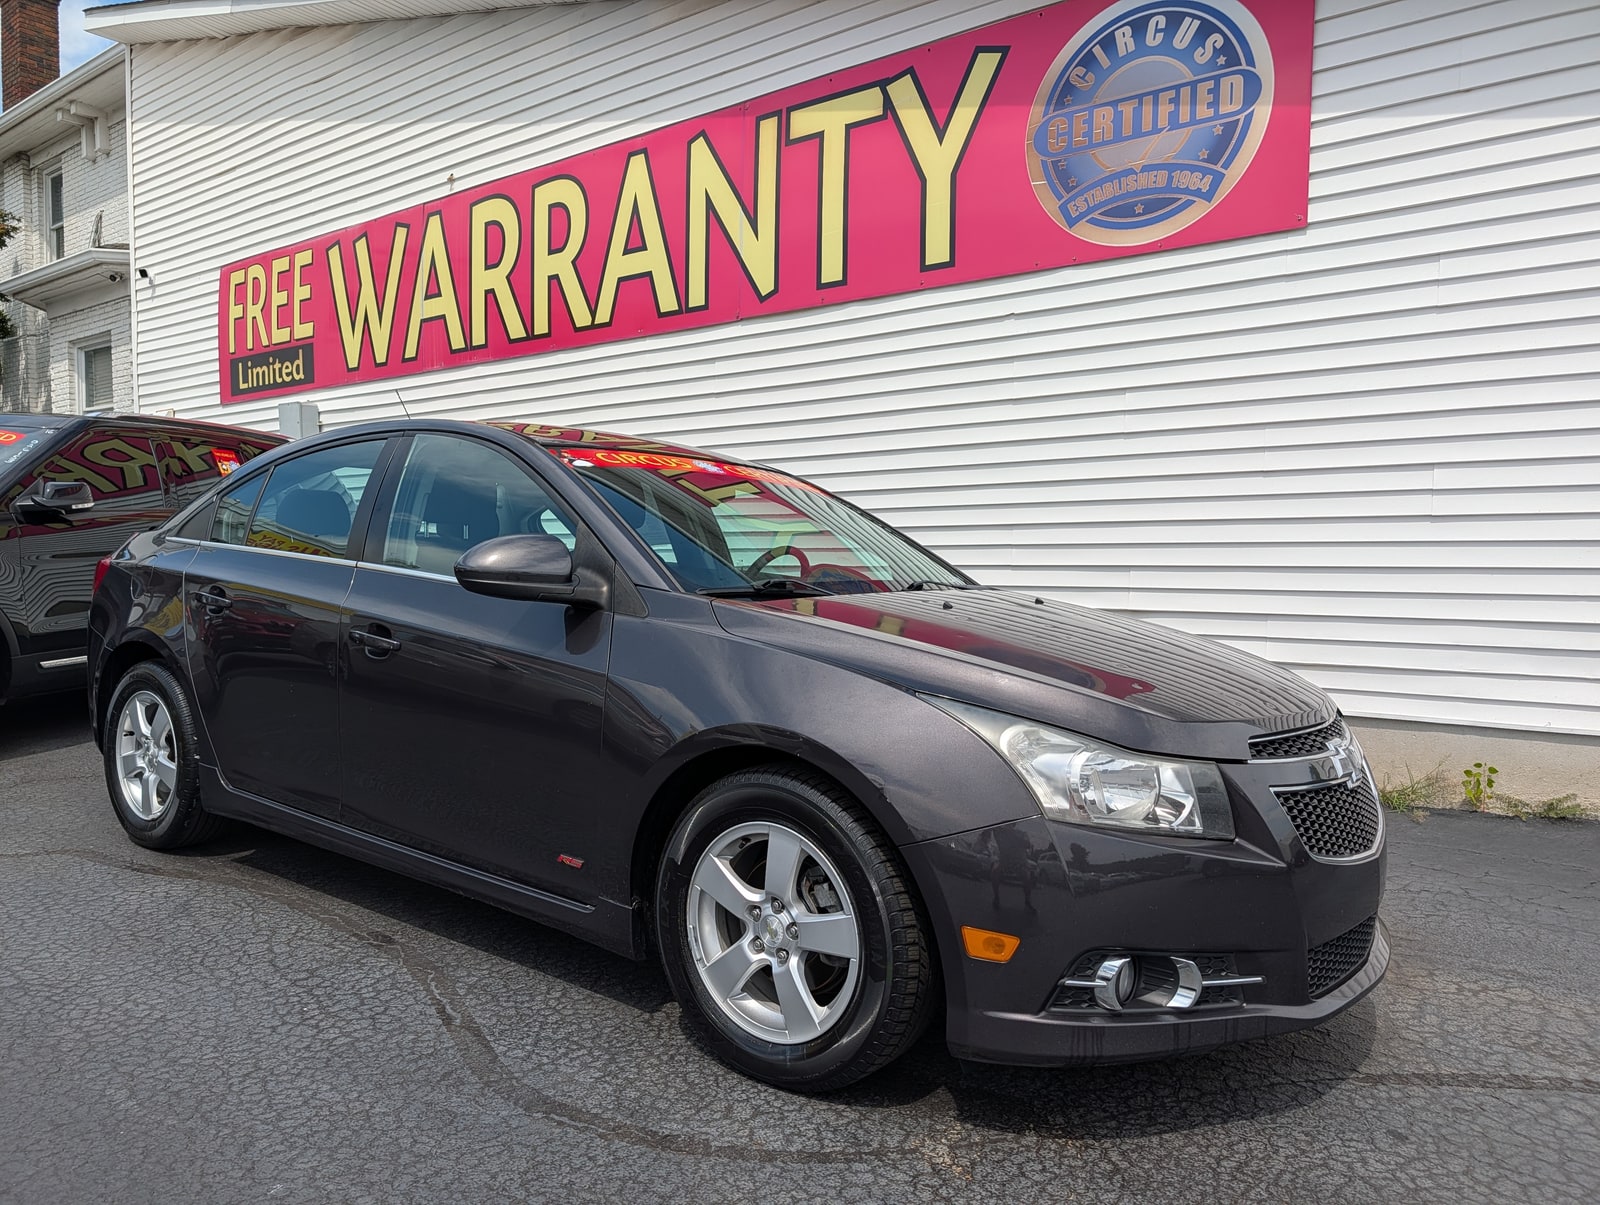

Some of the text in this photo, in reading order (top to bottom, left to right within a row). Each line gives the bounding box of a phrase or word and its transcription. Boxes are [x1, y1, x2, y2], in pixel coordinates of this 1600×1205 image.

[1069, 14, 1225, 92] CIRCUS
[1047, 74, 1245, 153] CERTIFIED
[228, 45, 1011, 371] FREE WARRANTY
[1067, 169, 1212, 218] ESTABLISHED 1964
[238, 348, 305, 390] Limited
[595, 451, 692, 470] CIRCUS
